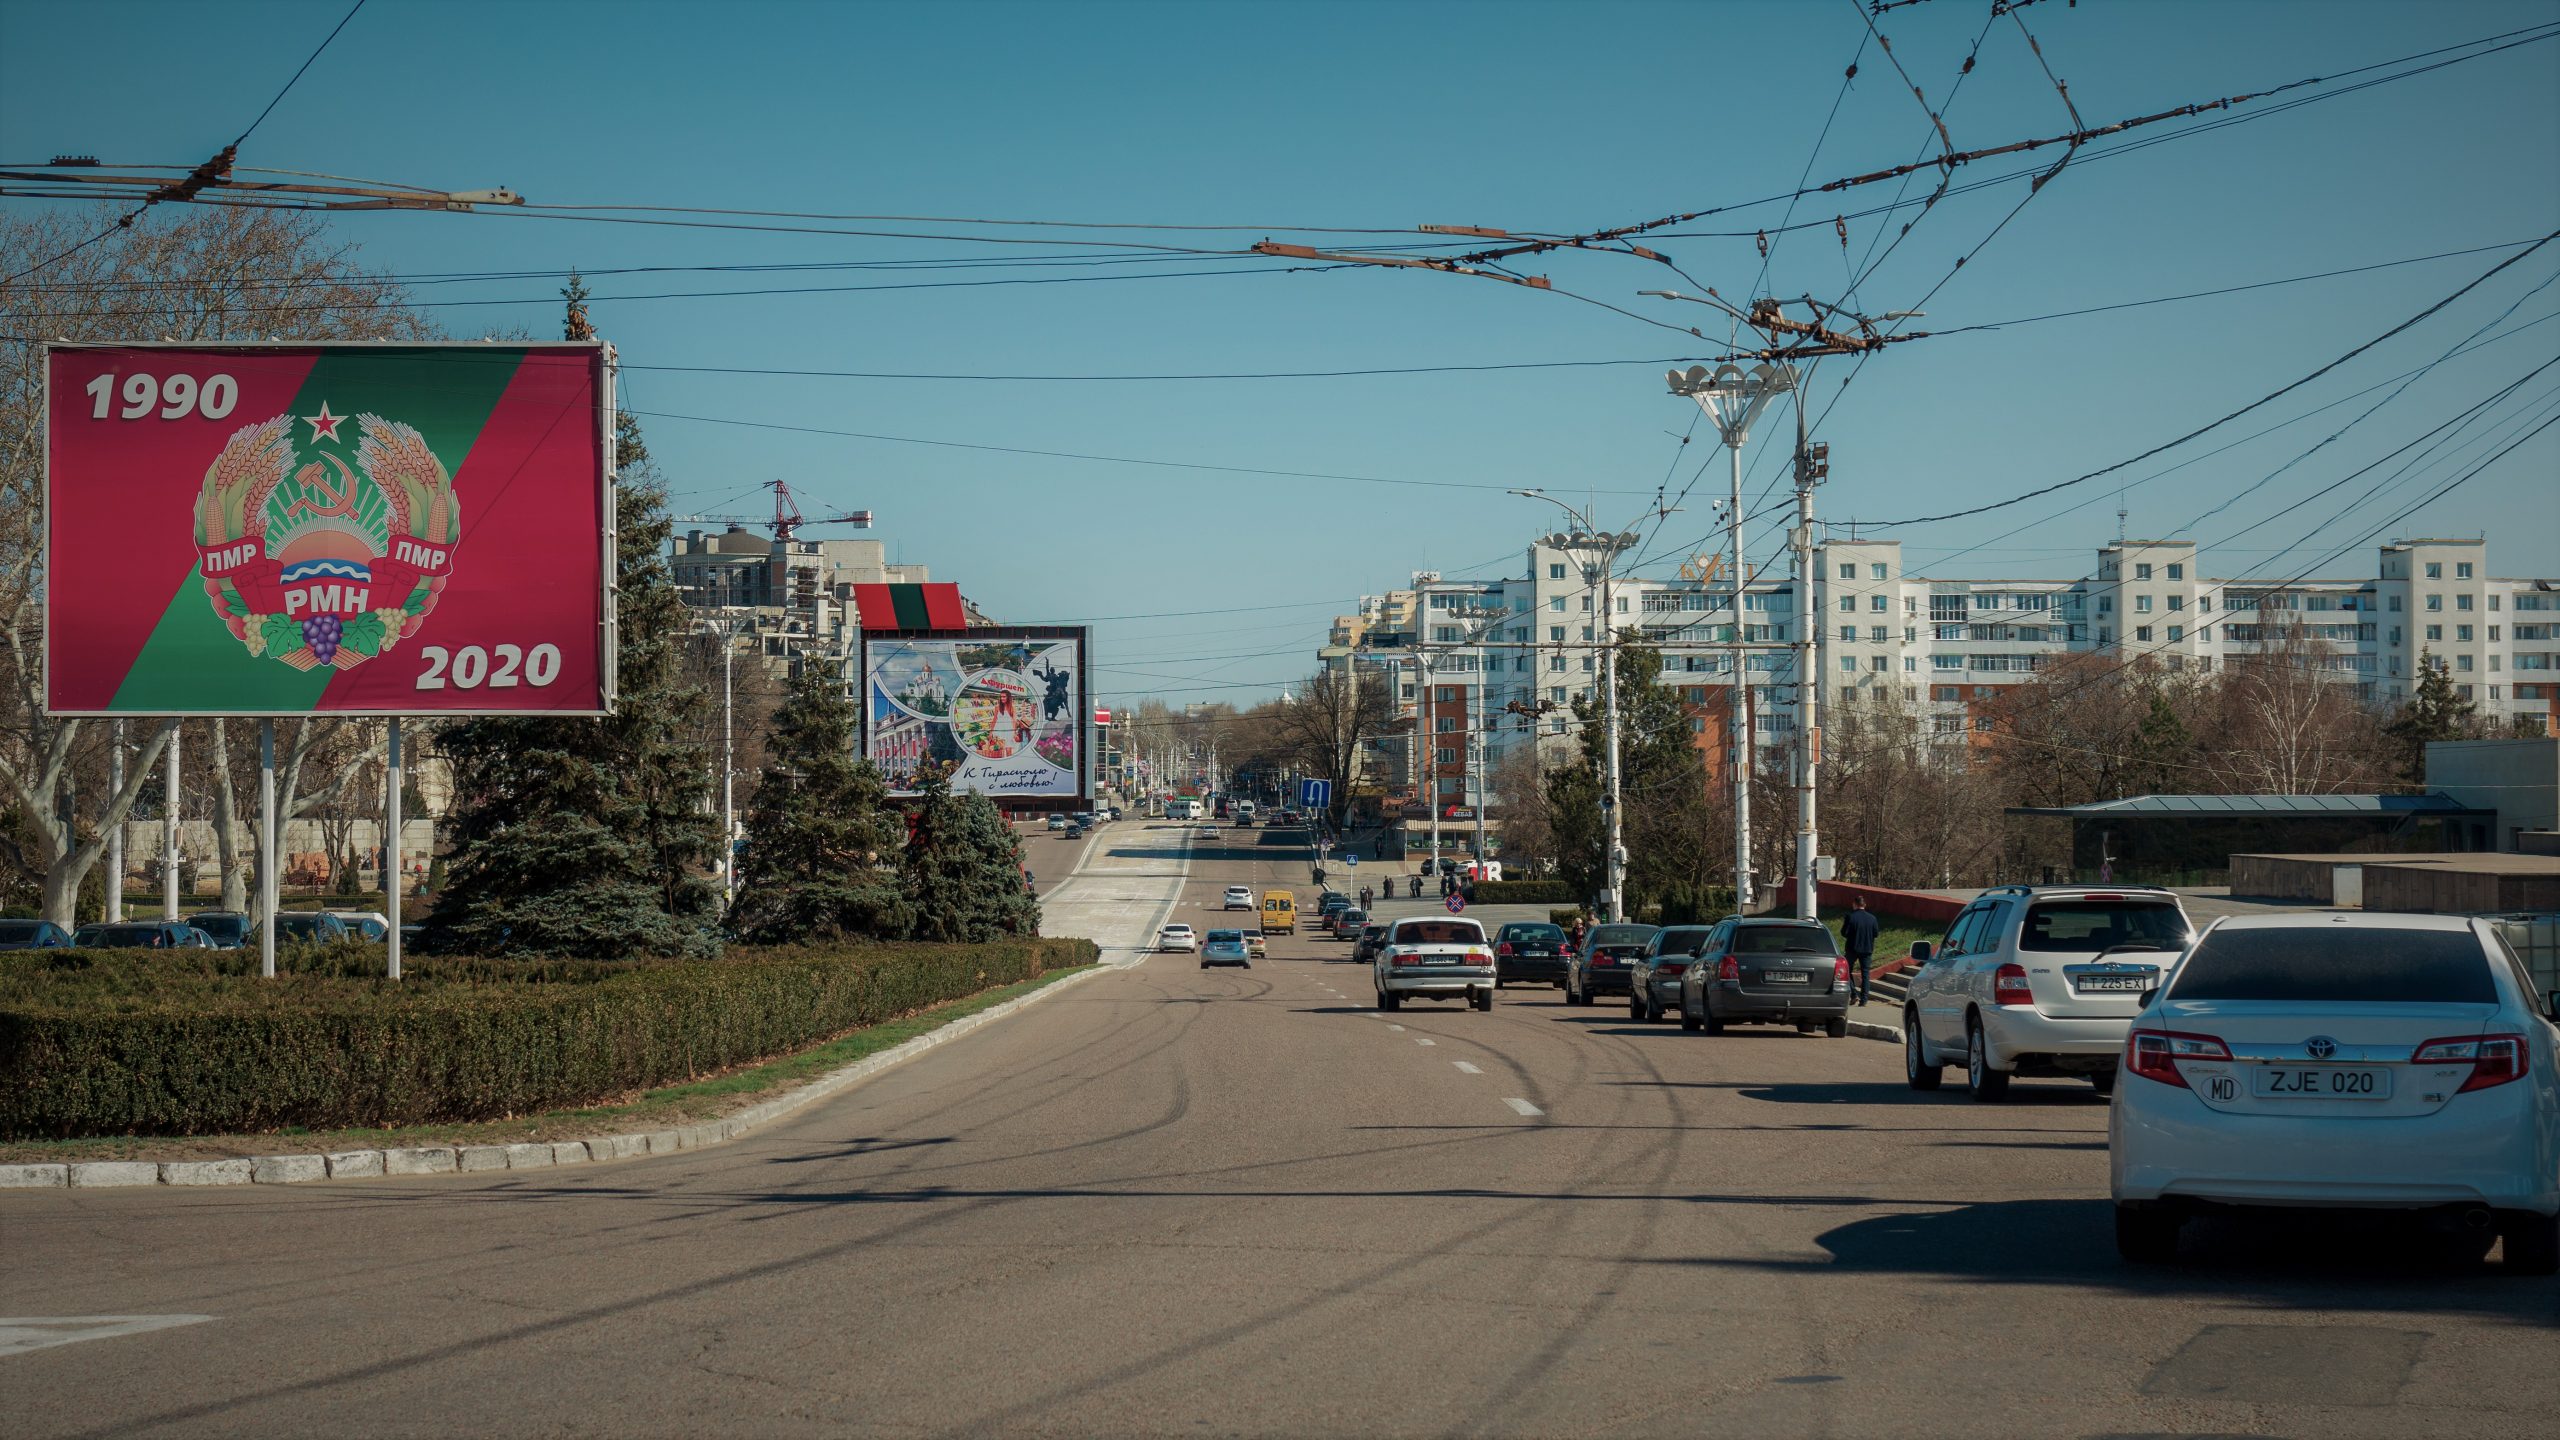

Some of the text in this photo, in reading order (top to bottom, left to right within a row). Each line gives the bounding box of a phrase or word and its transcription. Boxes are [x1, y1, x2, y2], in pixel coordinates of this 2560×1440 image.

[86, 373, 238, 421] 1990
[206, 542, 257, 572] ПМР
[394, 541, 446, 571] ПМР
[1679, 552, 1758, 586] KVIT
[284, 585, 369, 615] РМН
[415, 643, 562, 691] 2020
[963, 767, 1047, 781] К Тирасполю
[1000, 772, 1057, 790] любовью!
[2090, 977, 2141, 989] T 225 EX
[2211, 1078, 2234, 1100] MD
[2270, 1071, 2373, 1093] ZJE 020
